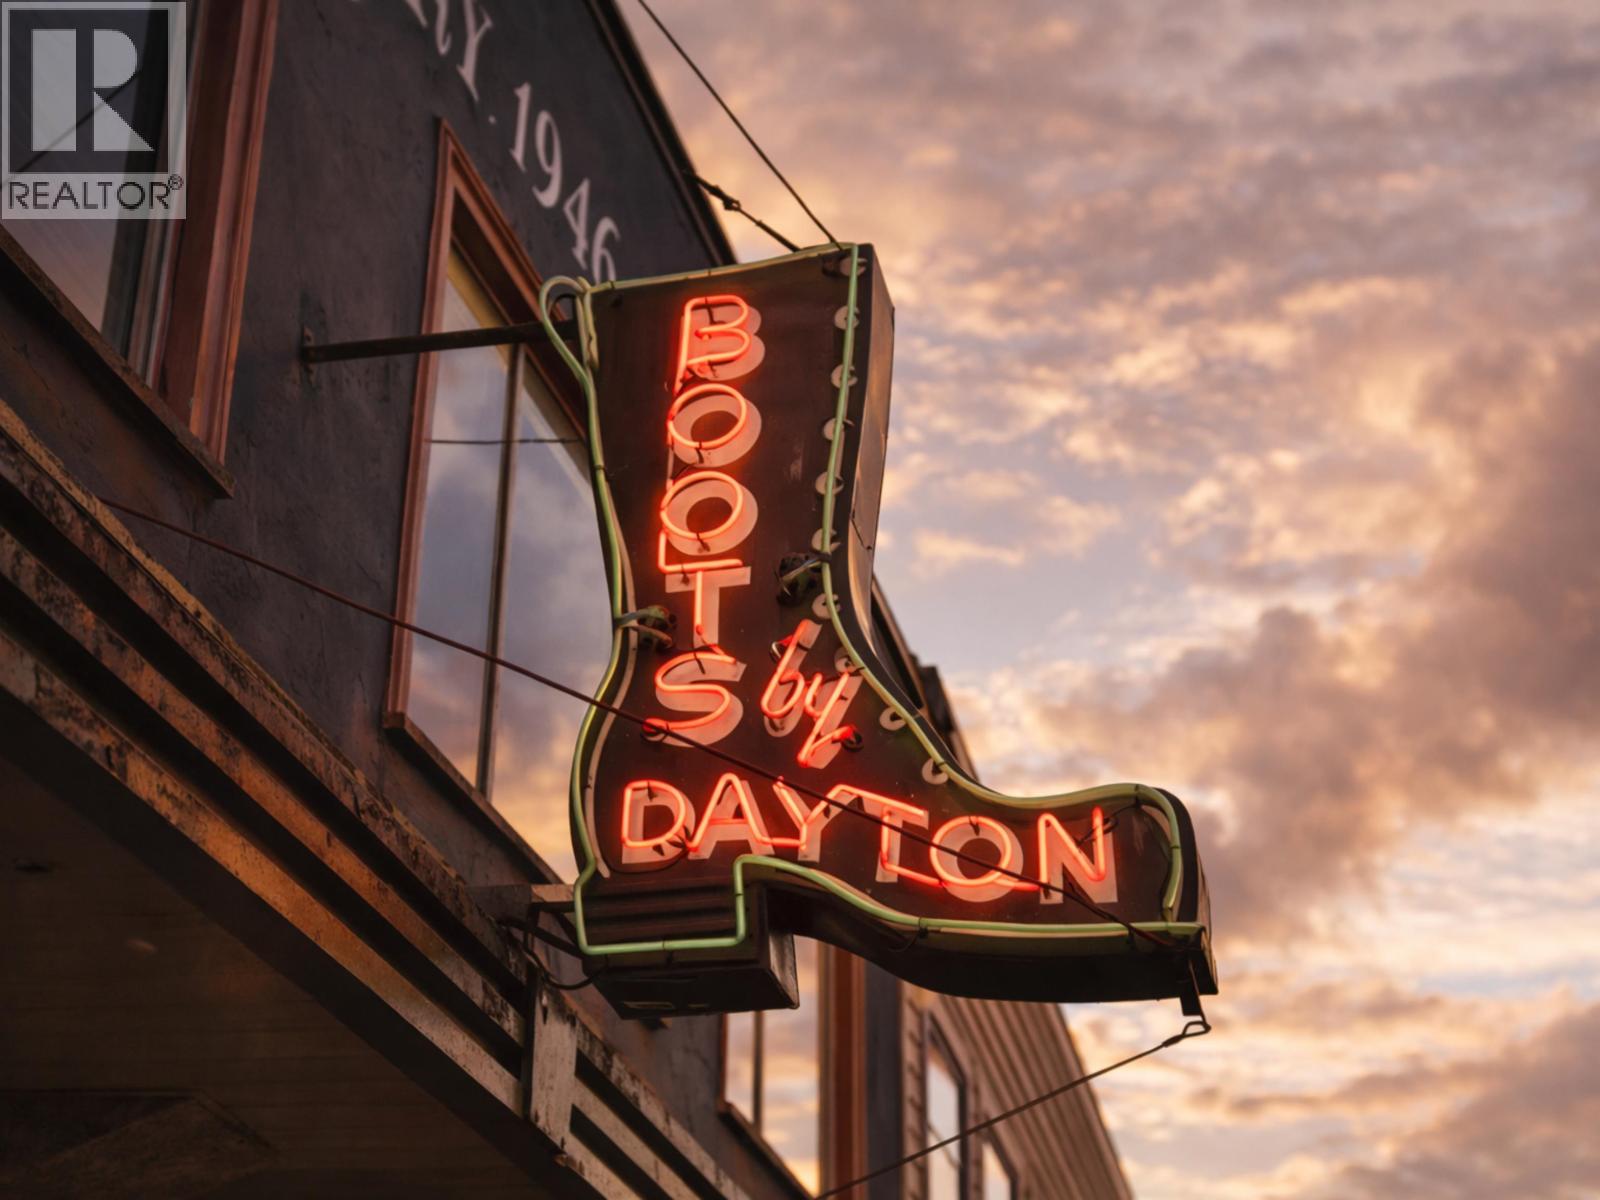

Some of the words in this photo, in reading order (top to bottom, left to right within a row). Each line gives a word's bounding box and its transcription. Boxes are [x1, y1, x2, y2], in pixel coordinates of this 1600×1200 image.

[509, 81, 621, 284] 1946
[644, 295, 766, 747] BOOTS
[761, 618, 863, 769] by
[620, 772, 1118, 904] DAYTON
